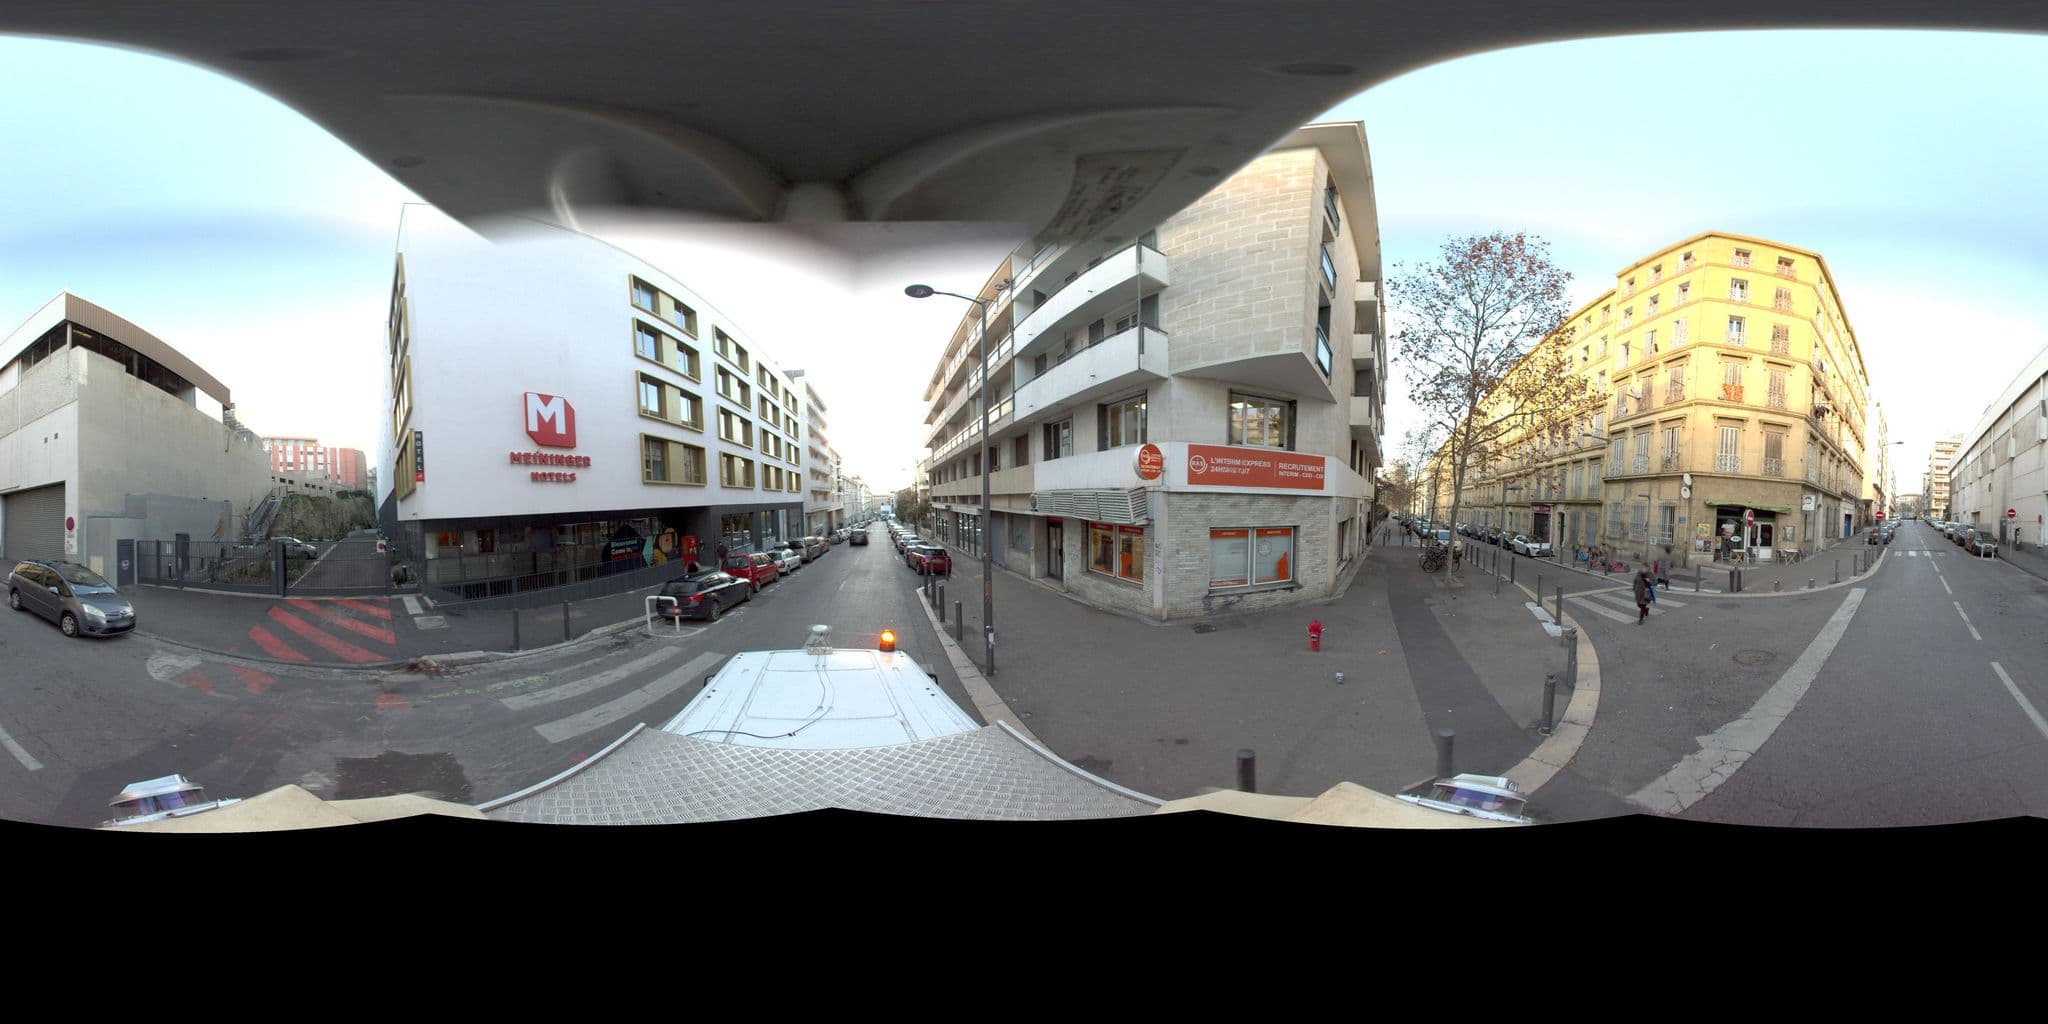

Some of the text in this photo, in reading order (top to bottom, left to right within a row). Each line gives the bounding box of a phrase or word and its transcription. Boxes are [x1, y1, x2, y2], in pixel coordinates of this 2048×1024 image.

[526, 392, 567, 435] M
[509, 451, 591, 467] MEININGER
[1241, 459, 1271, 468] EXPRESS
[1278, 462, 1324, 473] RECRUTEMENT
[530, 471, 577, 483] HOTELS
[1278, 470, 1299, 478] INTERIM
